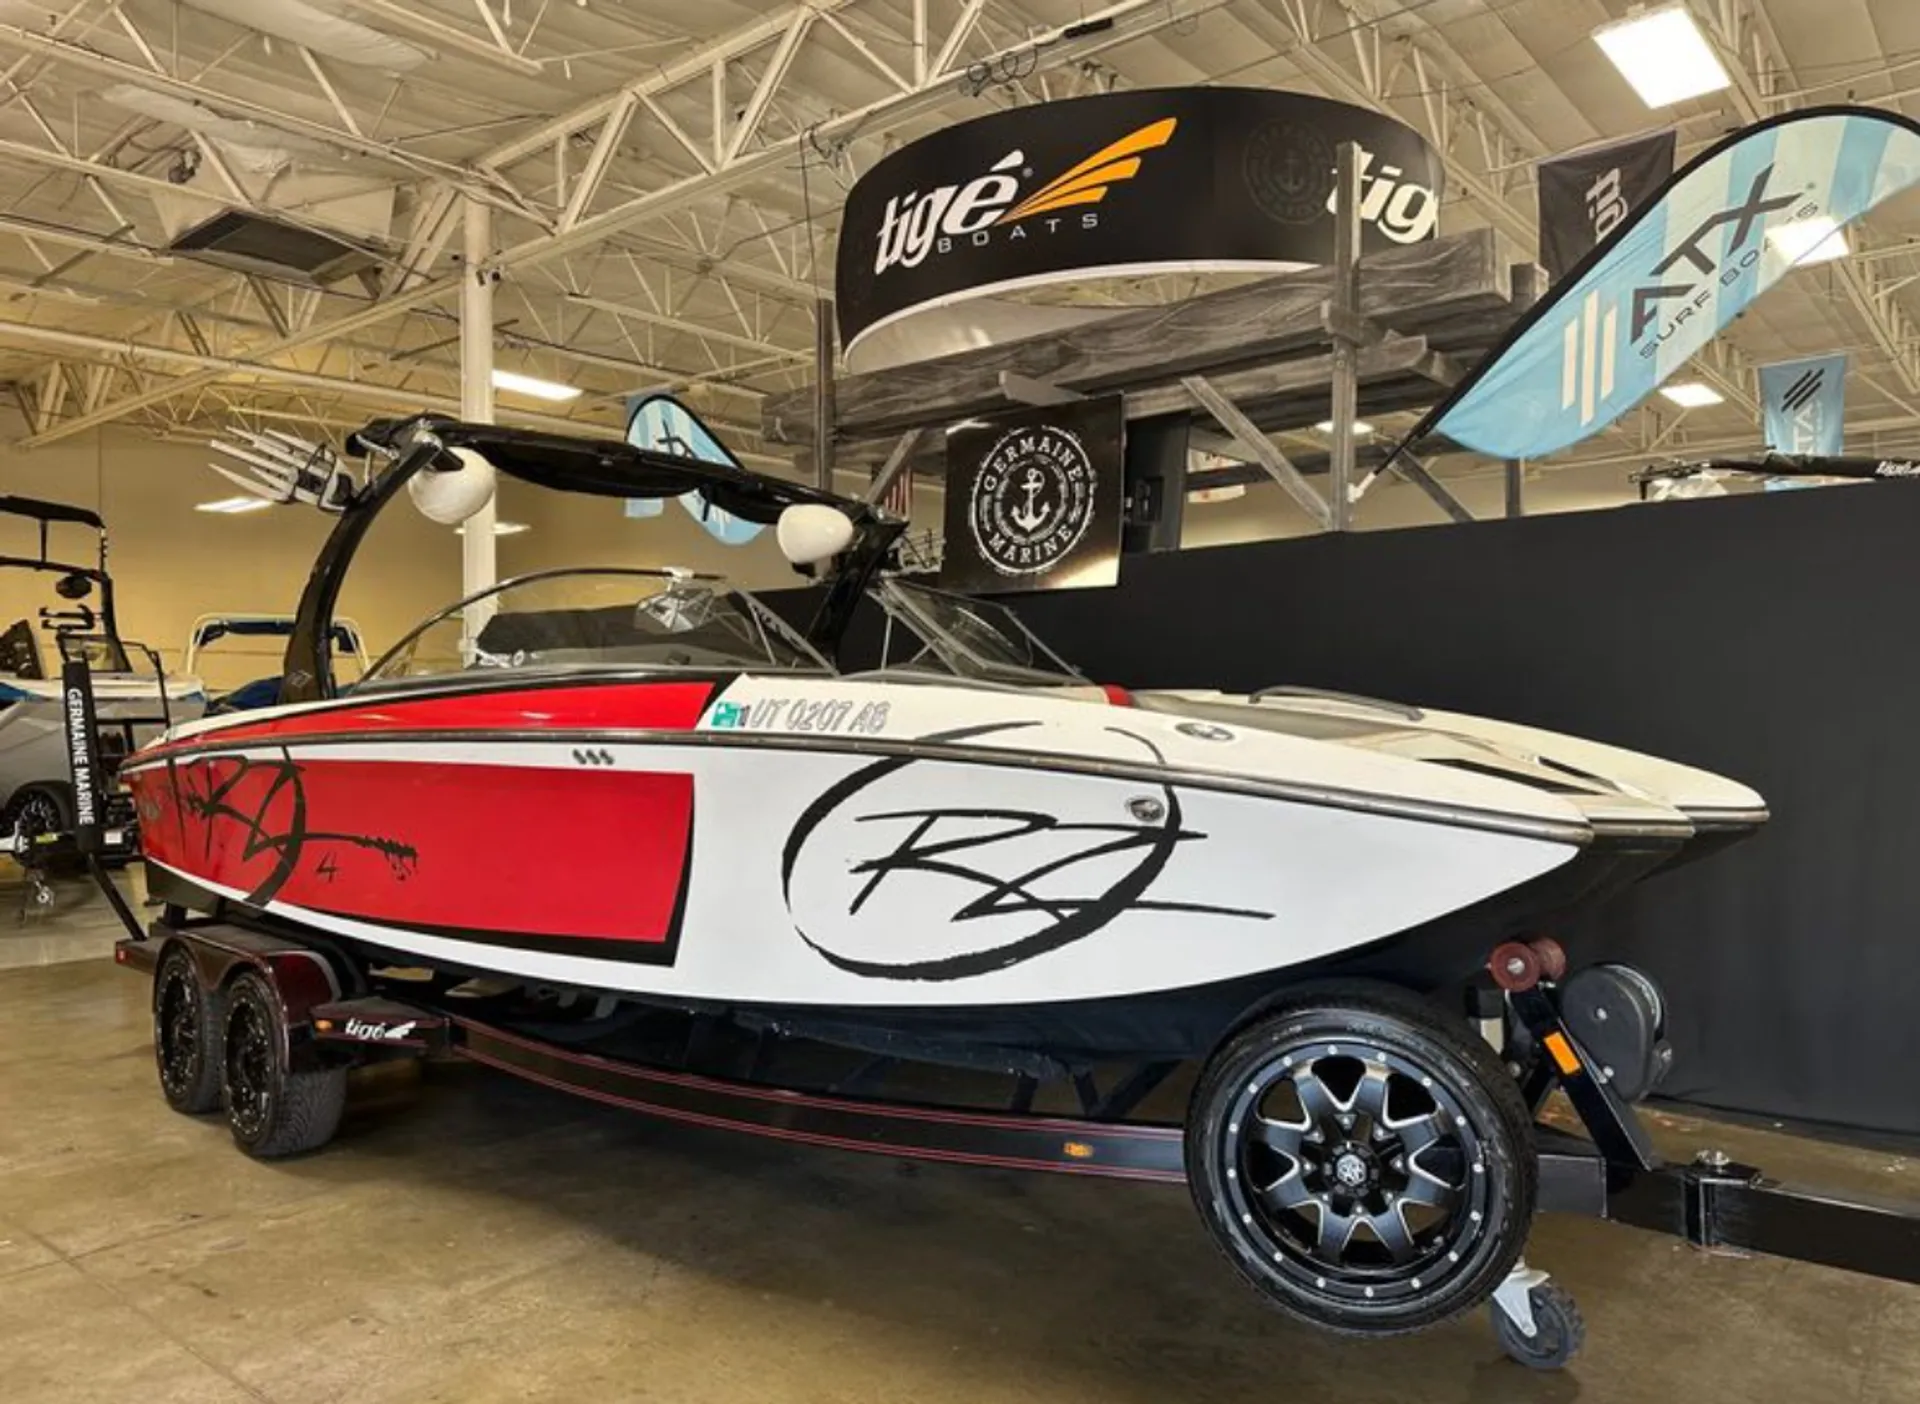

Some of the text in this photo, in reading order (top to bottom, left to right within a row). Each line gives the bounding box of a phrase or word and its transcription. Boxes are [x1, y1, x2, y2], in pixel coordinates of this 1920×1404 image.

[875, 149, 1025, 275] tigé
[937, 213, 1098, 254] BOATS
[1631, 162, 1804, 346] ATX
[1639, 290, 1712, 359] SURF
[983, 436, 1083, 492] GERMAINE
[988, 524, 1072, 564] MARINE
[751, 699, 790, 728] UT
[785, 699, 852, 731] 0207
[67, 688, 95, 825] GERMAINE MARINE
[316, 852, 338, 883] 4
